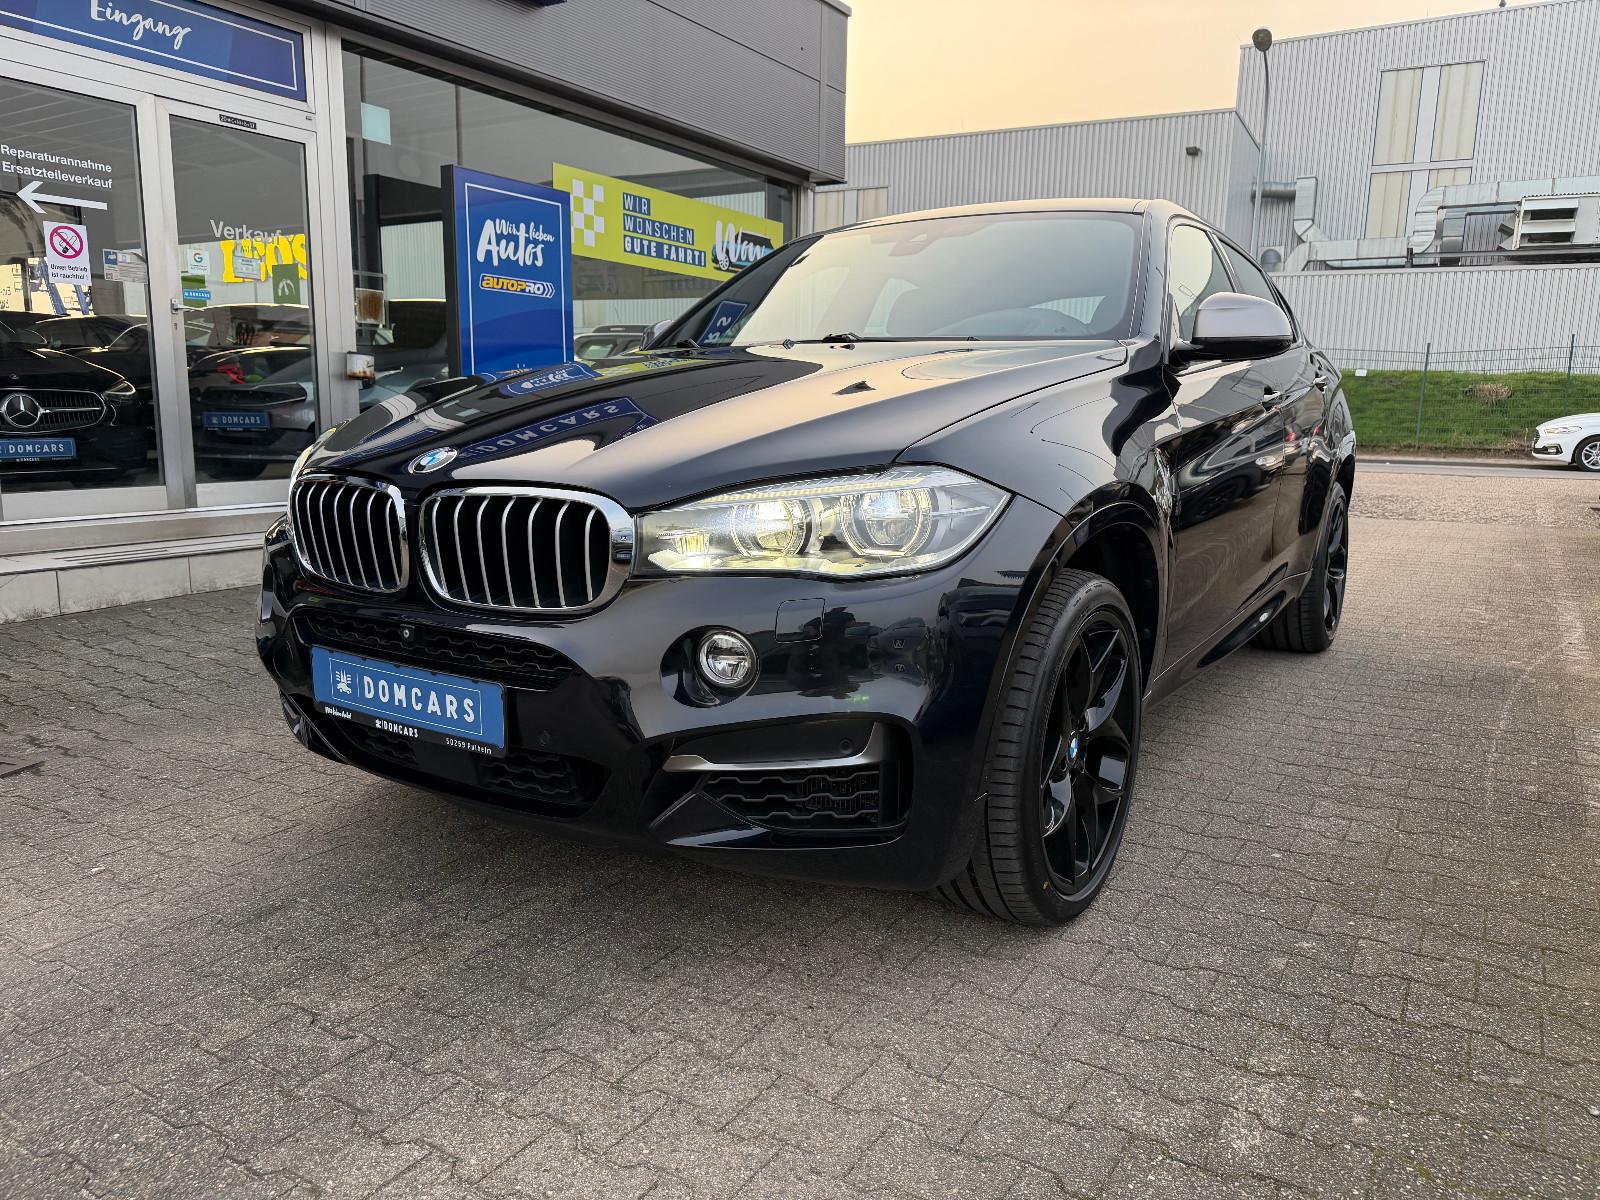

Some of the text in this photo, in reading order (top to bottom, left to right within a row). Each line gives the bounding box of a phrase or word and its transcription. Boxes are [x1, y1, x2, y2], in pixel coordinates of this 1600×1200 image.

[90, 0, 192, 50] Eingang
[1, 144, 112, 173] Reparaturannahme
[2, 161, 113, 189] Ersatzteileverkauf
[624, 194, 648, 214] WIR
[209, 219, 283, 244] Verkauf
[476, 218, 544, 267] Autos
[528, 221, 555, 242] lieben
[624, 215, 694, 245] WÜNSCHEN
[624, 236, 705, 266] GUTE FAHRT!
[222, 416, 261, 424] DOMCARS
[9, 444, 65, 454] DOMCARS
[363, 675, 476, 723] DOMCARS
[383, 720, 419, 738] DOMCARS
[445, 737, 466, 748] 50259
